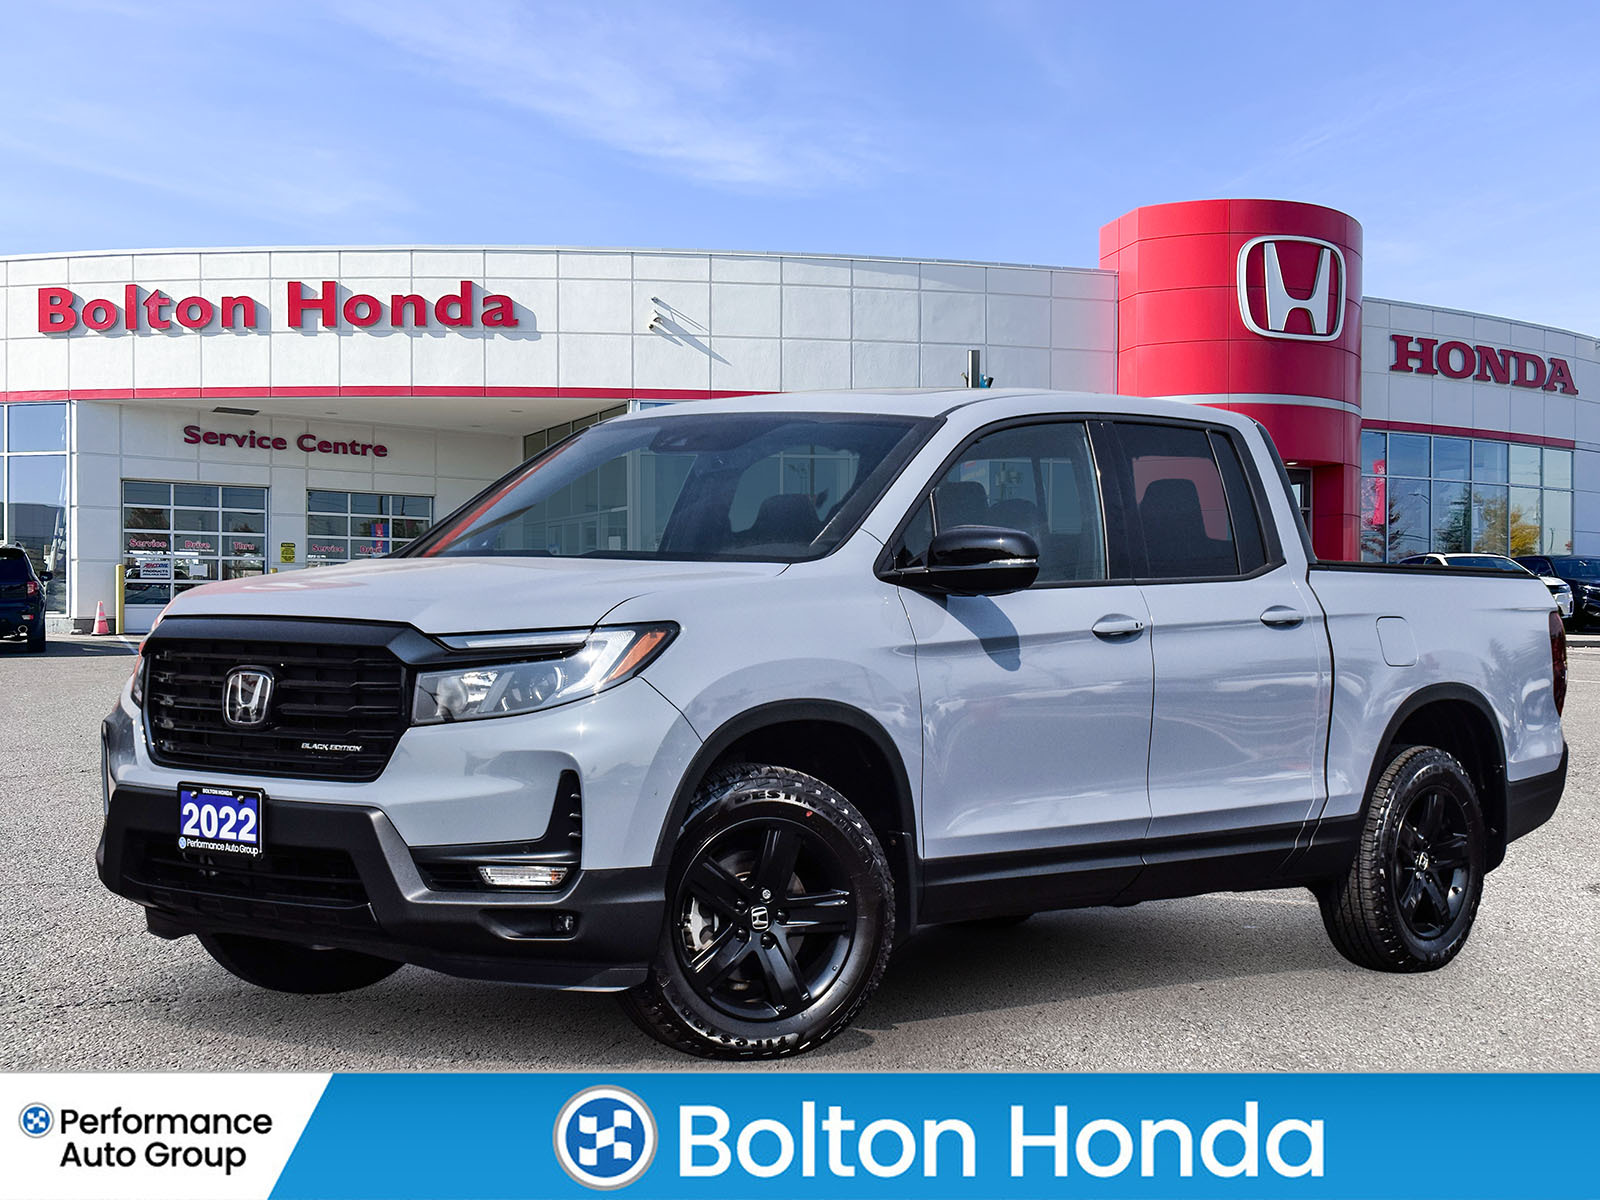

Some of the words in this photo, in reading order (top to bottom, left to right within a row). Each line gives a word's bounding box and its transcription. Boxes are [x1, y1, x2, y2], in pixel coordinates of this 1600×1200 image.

[38, 284, 256, 333] Bolton
[287, 280, 519, 329] Honda
[1390, 334, 1579, 396] HONDA
[183, 425, 287, 451] Service
[296, 433, 389, 458] Centre
[129, 539, 167, 548] Service
[184, 540, 211, 549] Drive
[232, 542, 255, 551] Thru
[311, 544, 344, 553] Service
[301, 742, 329, 751] BLACK
[329, 744, 363, 752] EDITION
[182, 802, 257, 842] 2022
[186, 839, 225, 851] Performance
[224, 843, 239, 853] Auto
[239, 845, 259, 857] Group
